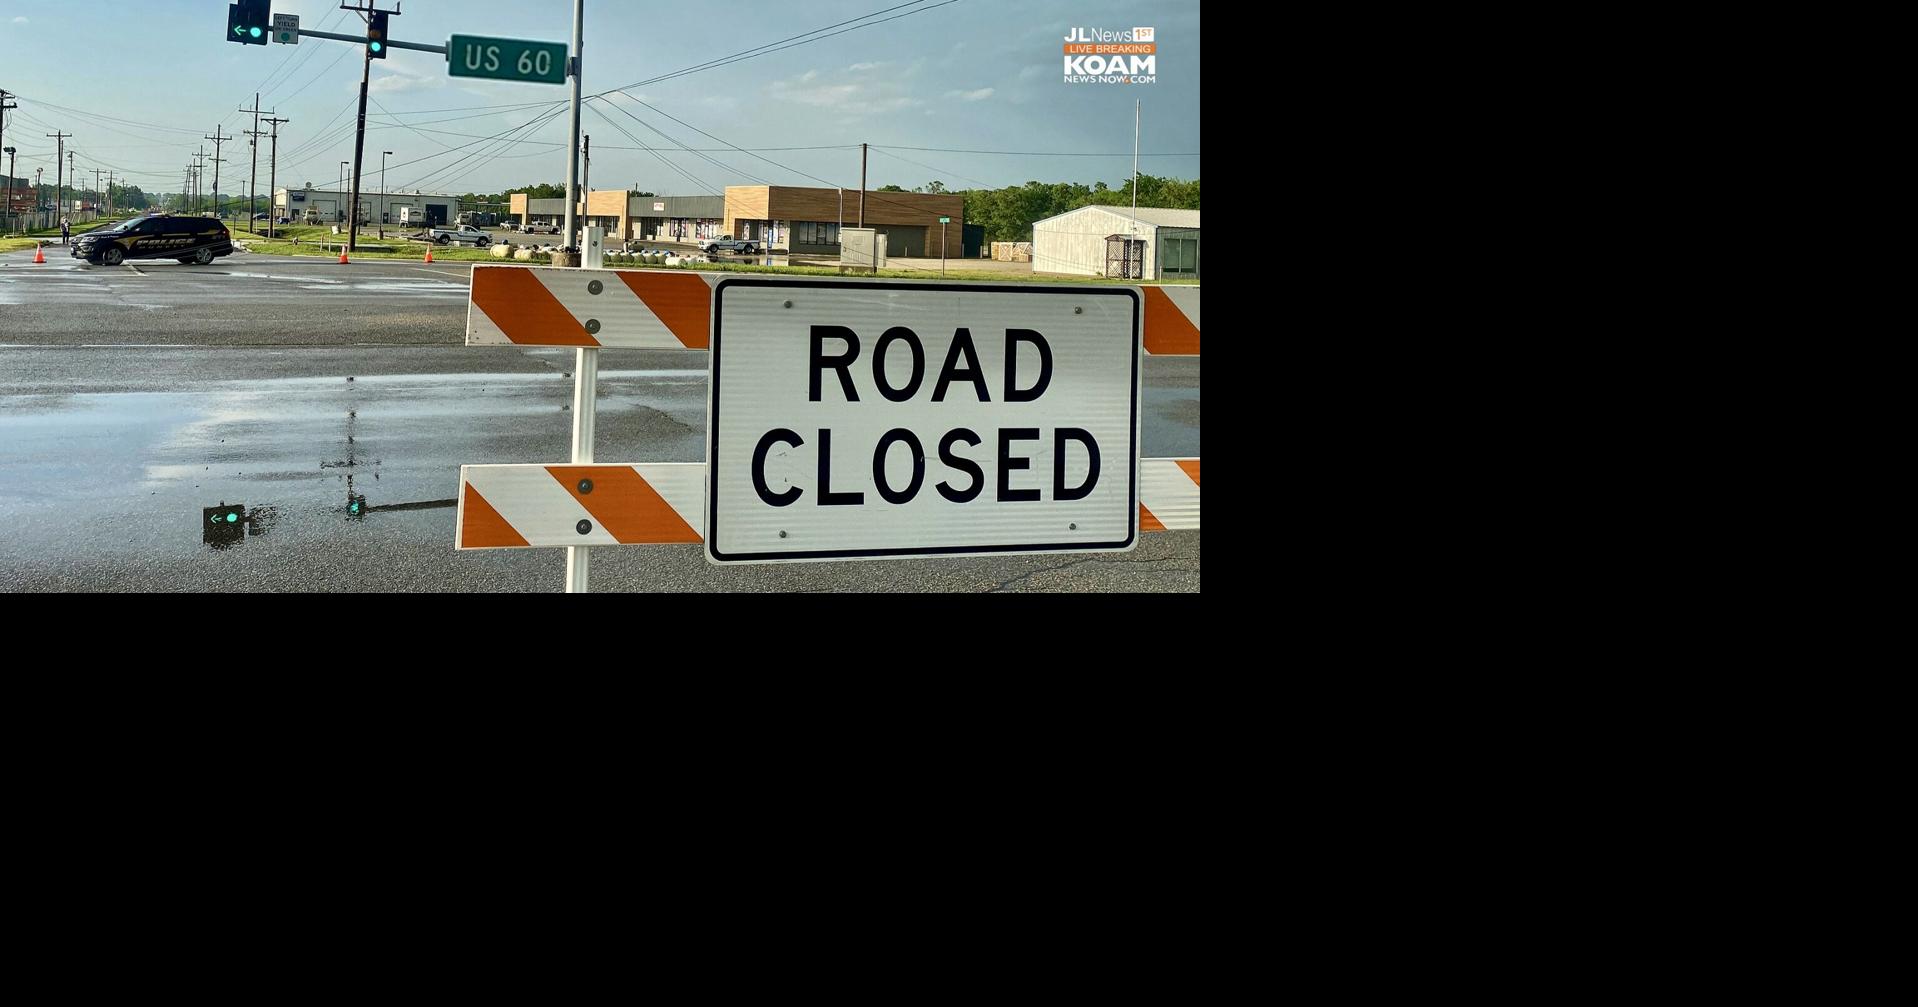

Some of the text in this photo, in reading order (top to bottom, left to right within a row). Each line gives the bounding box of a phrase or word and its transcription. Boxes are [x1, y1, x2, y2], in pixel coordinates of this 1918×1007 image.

[466, 44, 551, 75] US 60
[808, 325, 1053, 402] ROAD
[751, 428, 1101, 507] CLOSED
